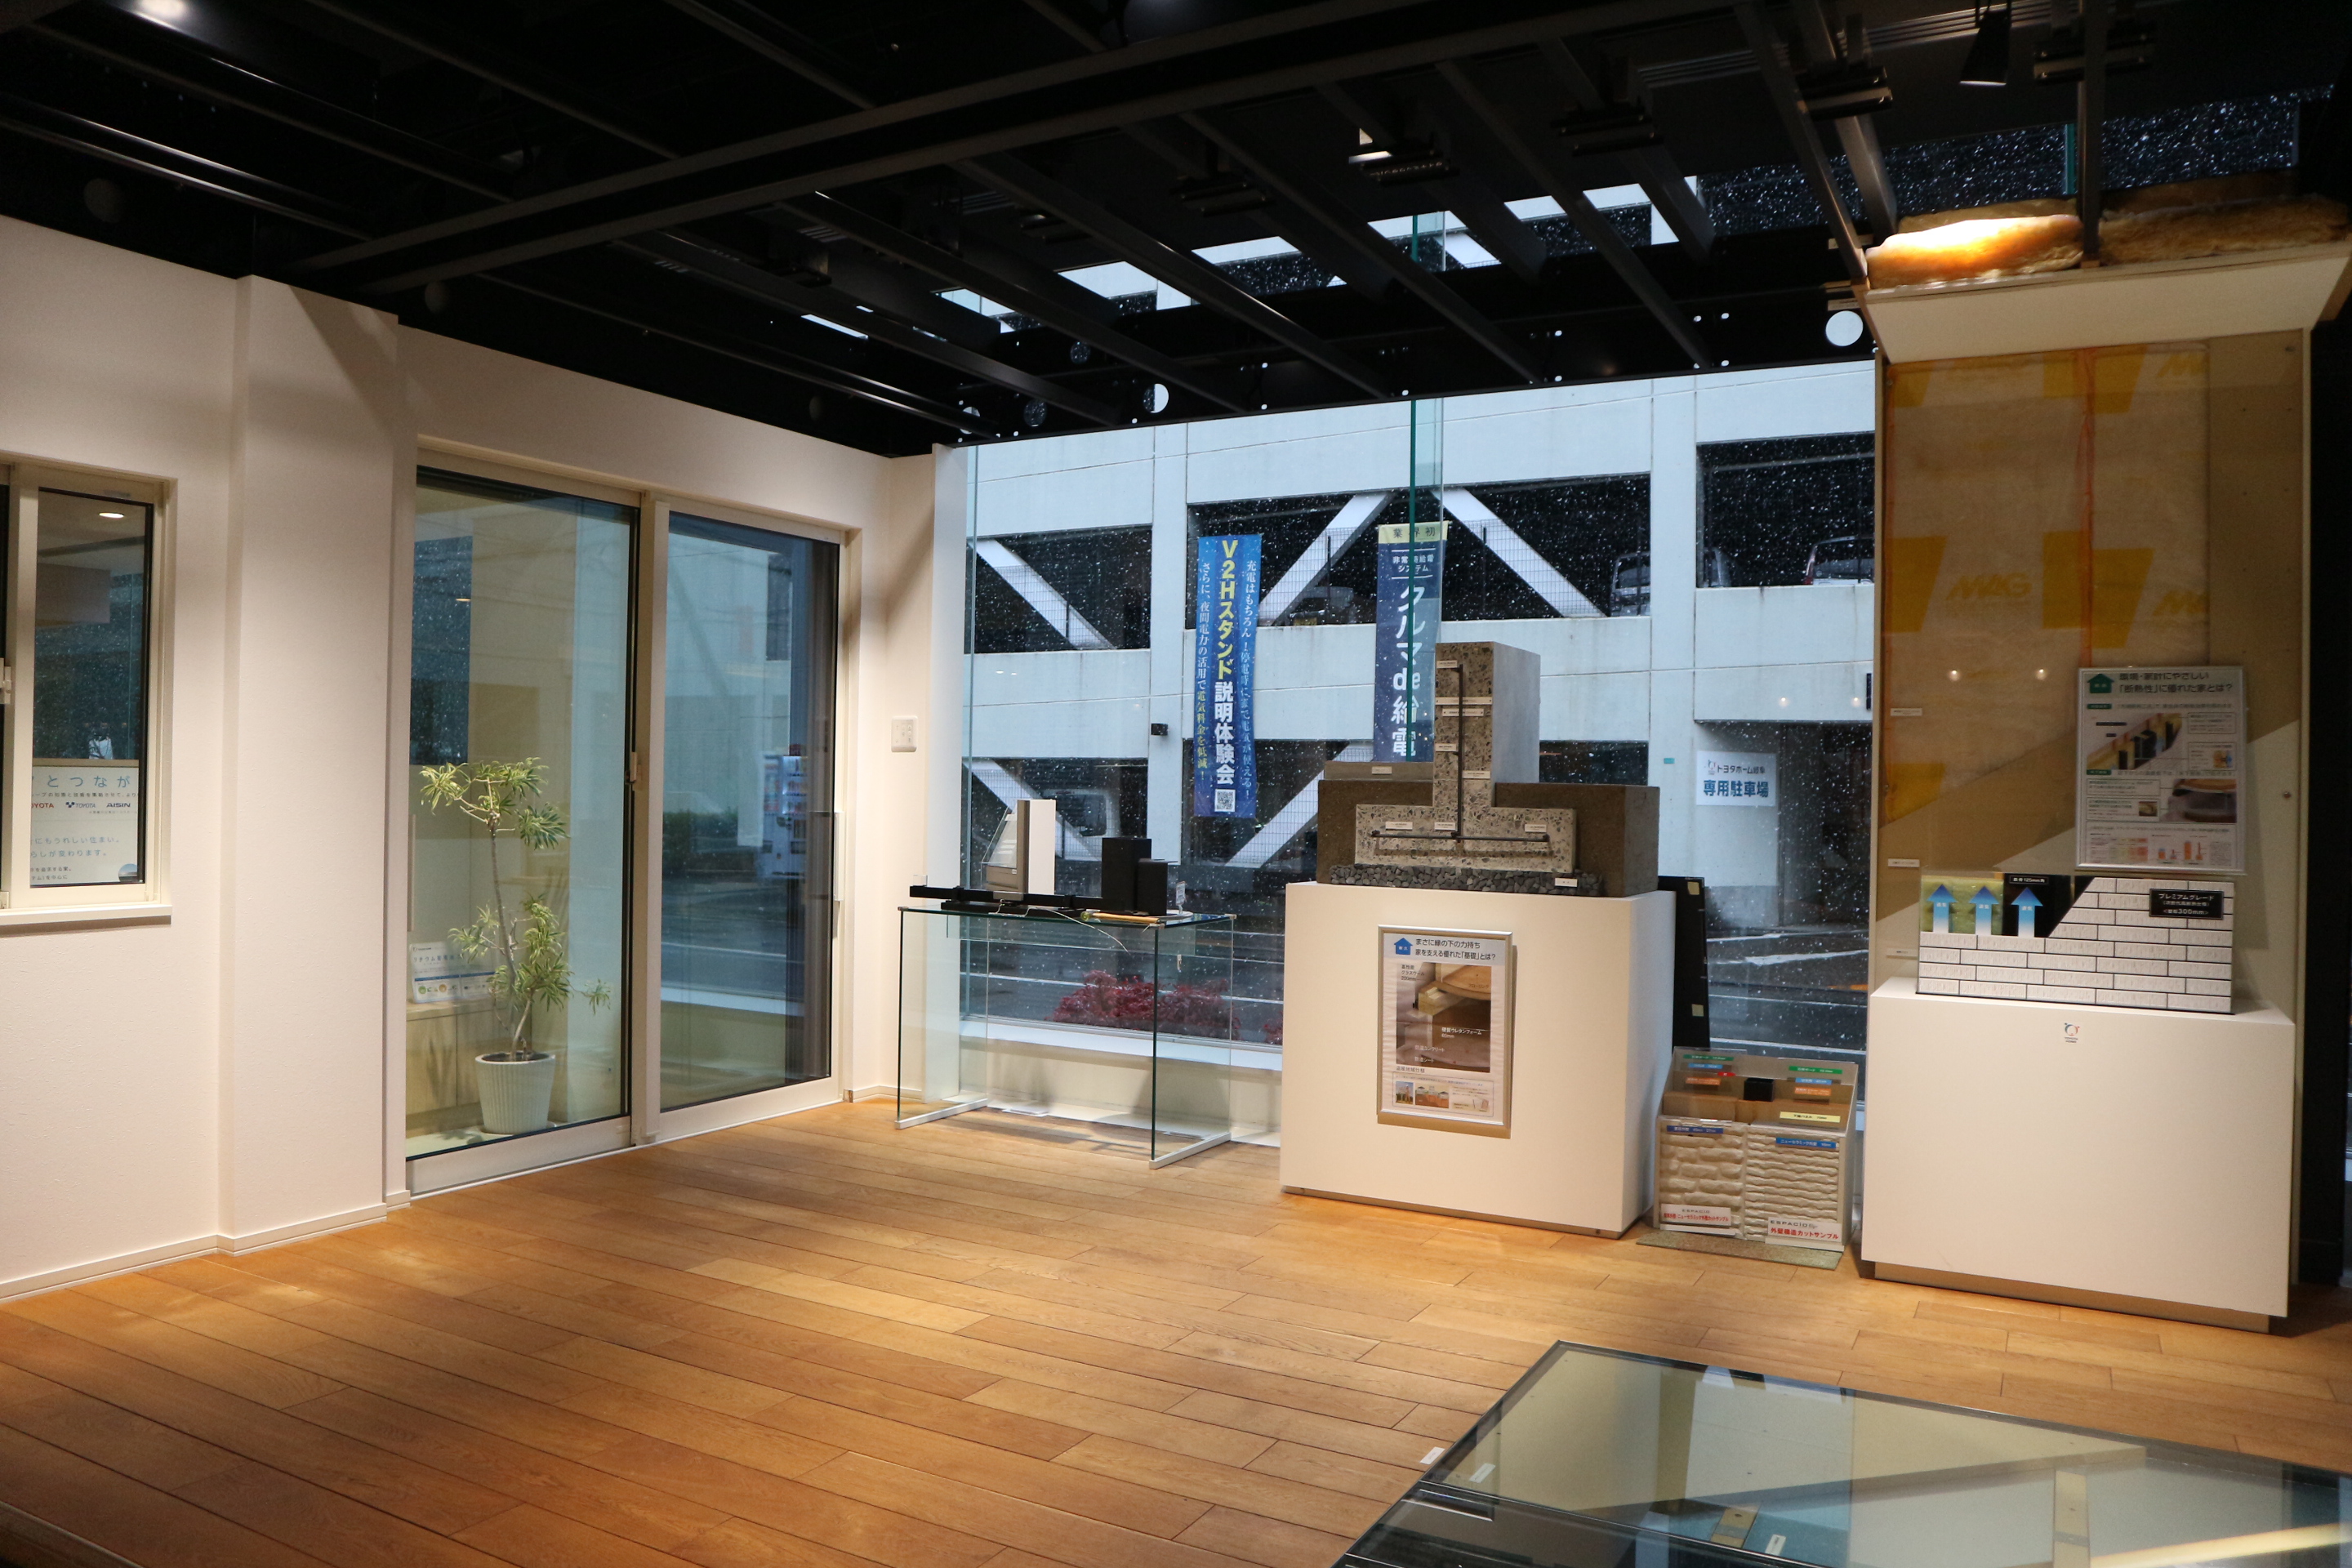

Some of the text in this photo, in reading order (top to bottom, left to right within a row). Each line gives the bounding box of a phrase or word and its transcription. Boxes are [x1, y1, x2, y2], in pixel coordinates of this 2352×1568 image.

[1392, 526, 1436, 538] 業界初
[1214, 540, 1239, 785] V2Hスタンド説明体験会
[32, 775, 130, 788] とつなが
[1704, 779, 1770, 799] 専用駐車場
[2158, 893, 2215, 902] プレミアムグレード
[1415, 938, 1481, 949] まさに縁の下の力持ち
[1771, 1227, 1839, 1240] 外壁構造カットサンプル
